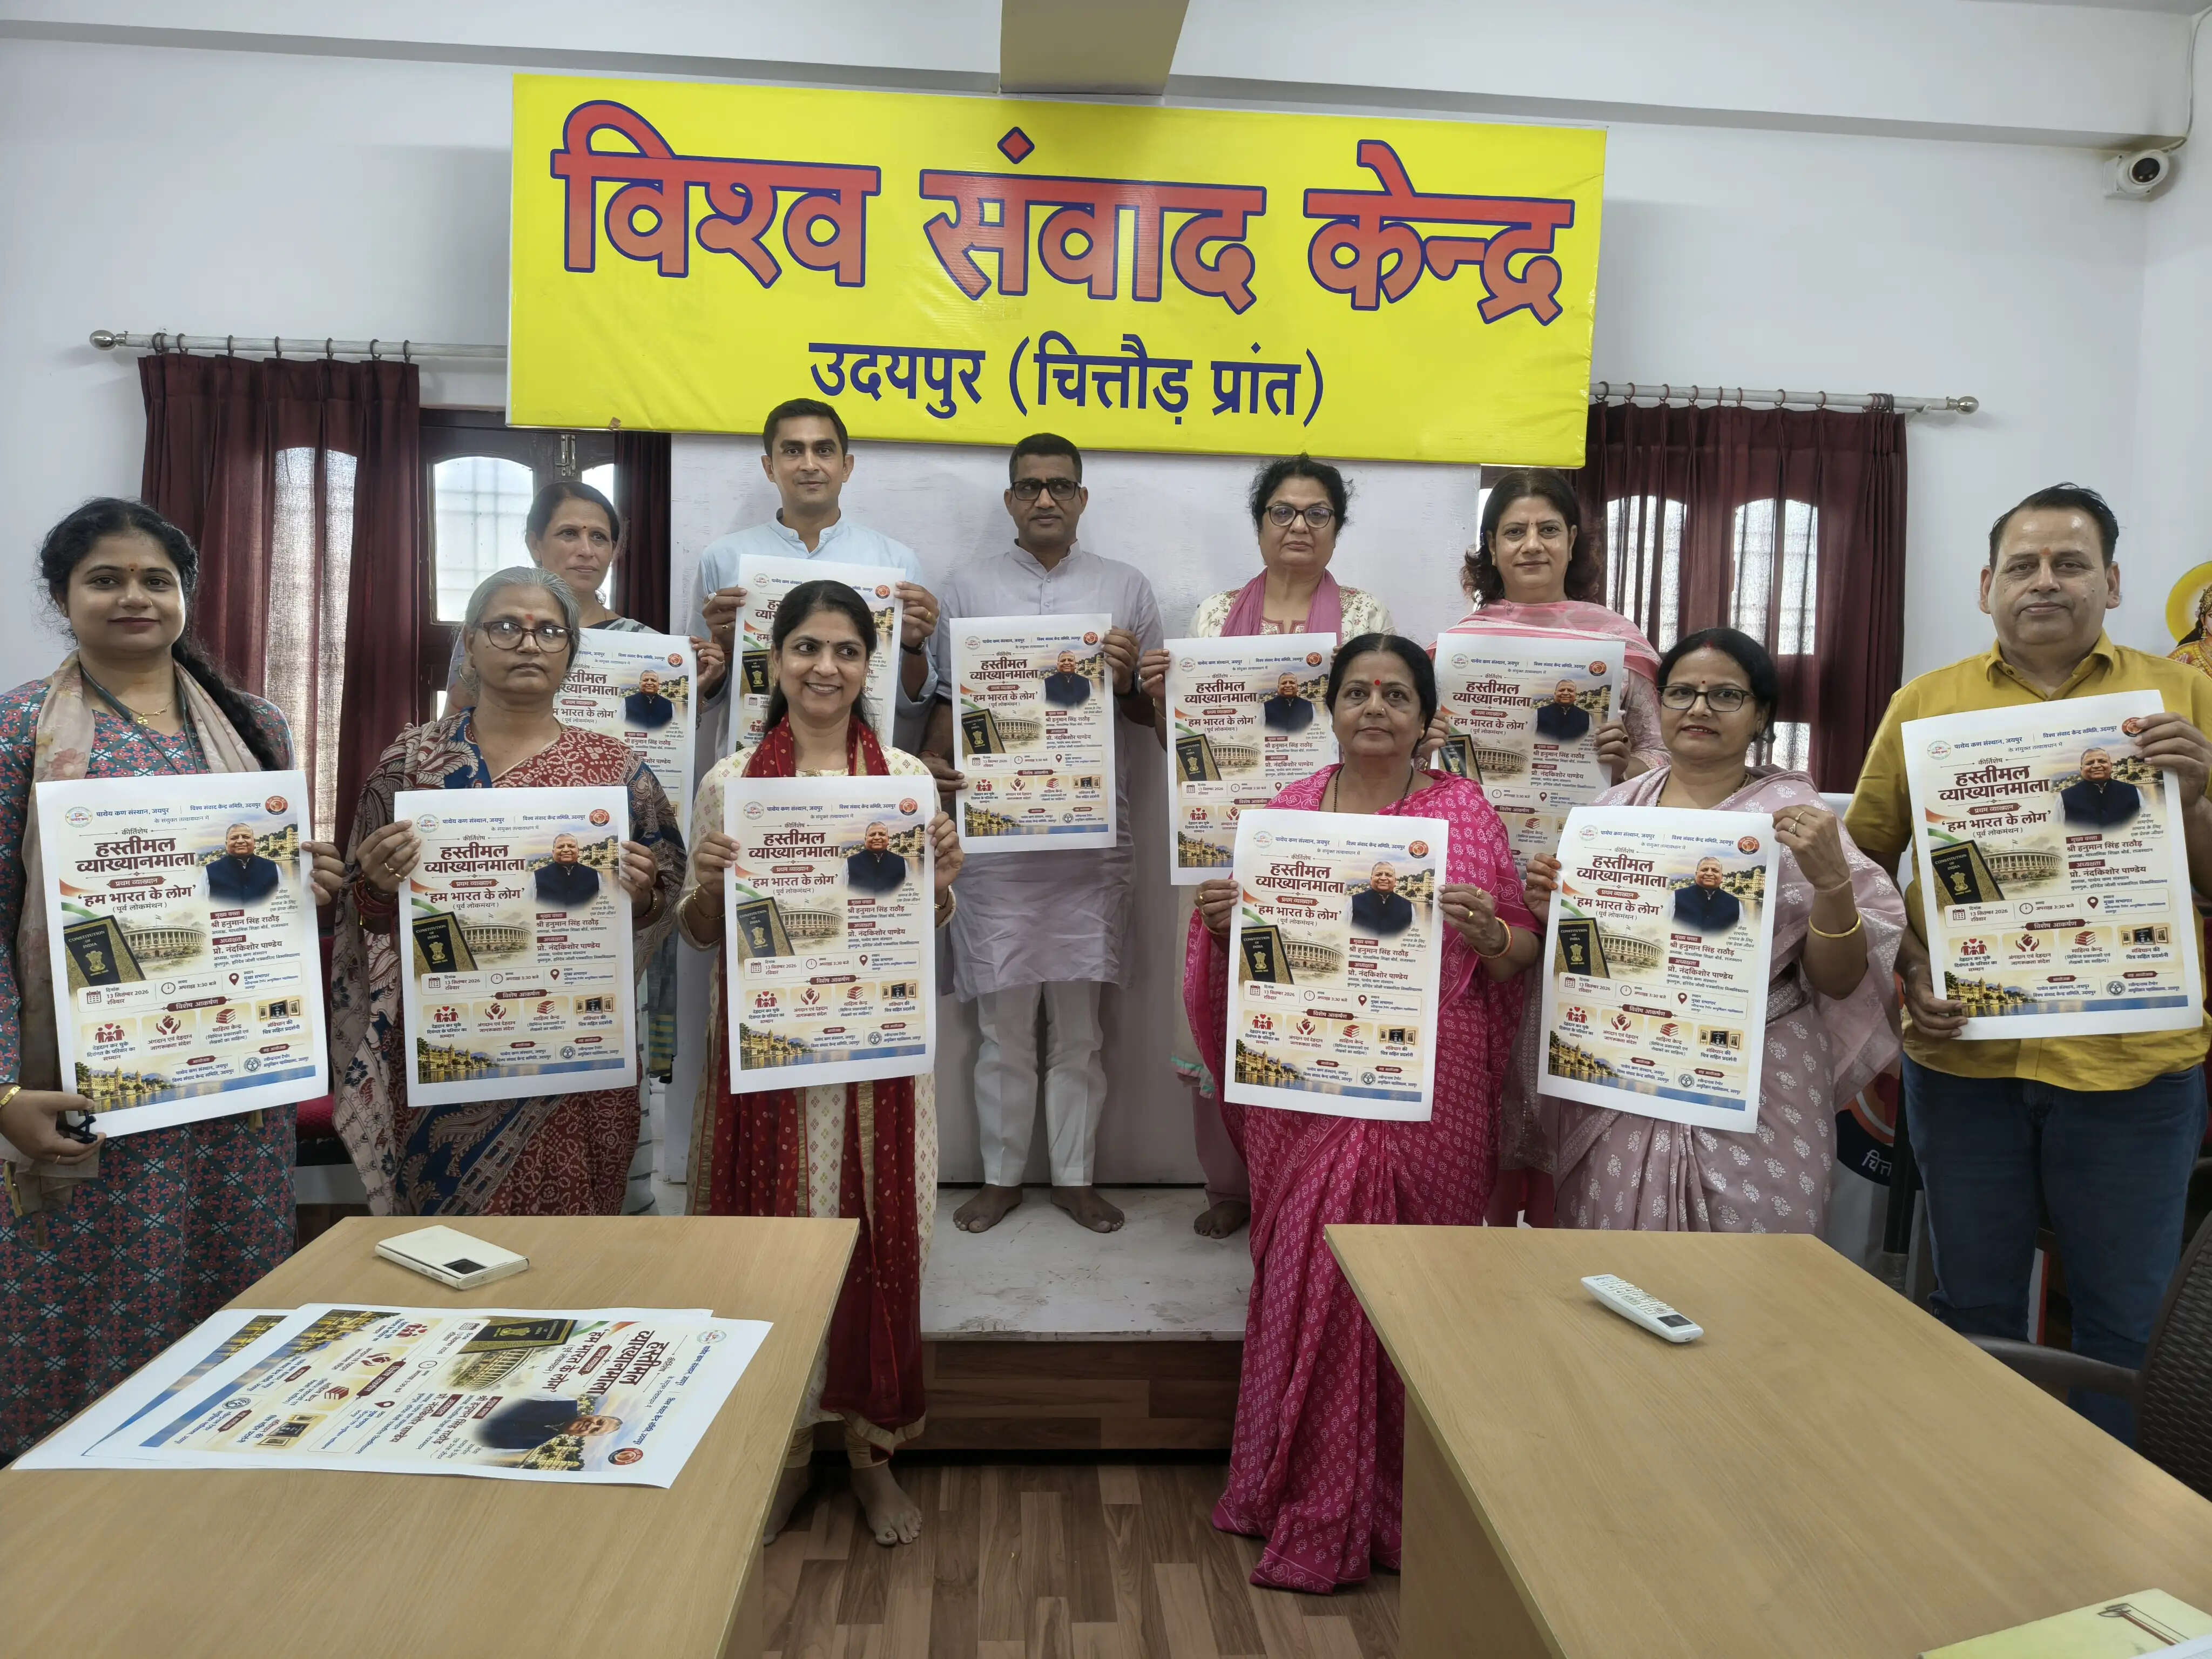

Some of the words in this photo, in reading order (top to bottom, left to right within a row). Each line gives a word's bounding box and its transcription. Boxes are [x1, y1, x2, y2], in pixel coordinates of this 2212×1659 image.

[550, 100, 881, 289] विश्व
[919, 127, 1267, 315] संवाद
[1303, 139, 1575, 326] केन्द्र
[809, 343, 986, 419] उदयपुर
[1009, 331, 1192, 425] (चित्तौड़
[1211, 343, 1323, 426] प्रांत)
[980, 656, 1027, 670] हस्तीमल
[1196, 679, 1245, 693] हस्तीमल
[1466, 679, 1520, 694] हस्तीमल
[1009, 691, 1018, 700] के
[1452, 692, 1531, 706] व्याख्यानमाला
[1226, 715, 1235, 725] के
[1469, 719, 1494, 727] भारत
[1495, 718, 1505, 729] के
[1954, 765, 2029, 786] हस्तीमल
[1939, 779, 2049, 800] व्याख्यानमाला
[1969, 817, 2002, 828] भारत
[2005, 812, 2018, 825] के
[764, 828, 825, 846] हस्तीमल
[95, 835, 175, 857] हस्तीमल
[440, 841, 508, 860] हस्तीमल
[748, 845, 838, 859] व्याख्यानमाला
[2077, 844, 2102, 853] हनुमान
[76, 852, 194, 872] व्याख्यानमाला
[424, 858, 524, 873] व्याख्यानमाला
[1270, 860, 1331, 878] हस्तीमल
[1591, 853, 1654, 872] हस्तीमल
[771, 876, 799, 886] भारत
[800, 873, 812, 885] के
[1576, 868, 1668, 887] व्याख्यानमाला
[2069, 869, 2081, 878] प्रो.
[1255, 876, 1344, 893] व्याख्यानमाला
[109, 891, 145, 902] भारत
[148, 886, 163, 899] के
[450, 891, 481, 901] भारत
[483, 887, 496, 900] के
[1276, 907, 1303, 917] भारत
[1304, 906, 1316, 918] के
[1595, 899, 1623, 911] भारत
[1624, 900, 1636, 912] के
[220, 919, 244, 928] हनुमान
[212, 946, 224, 954] प्रो.
[1379, 947, 1391, 955] सिंह
[1679, 943, 1700, 952] हनुमान
[1702, 945, 1715, 953] सिंह
[565, 1344, 594, 1364] भारत
[559, 1364, 580, 1373] के
[619, 1342, 669, 1385] हस्तीमल
